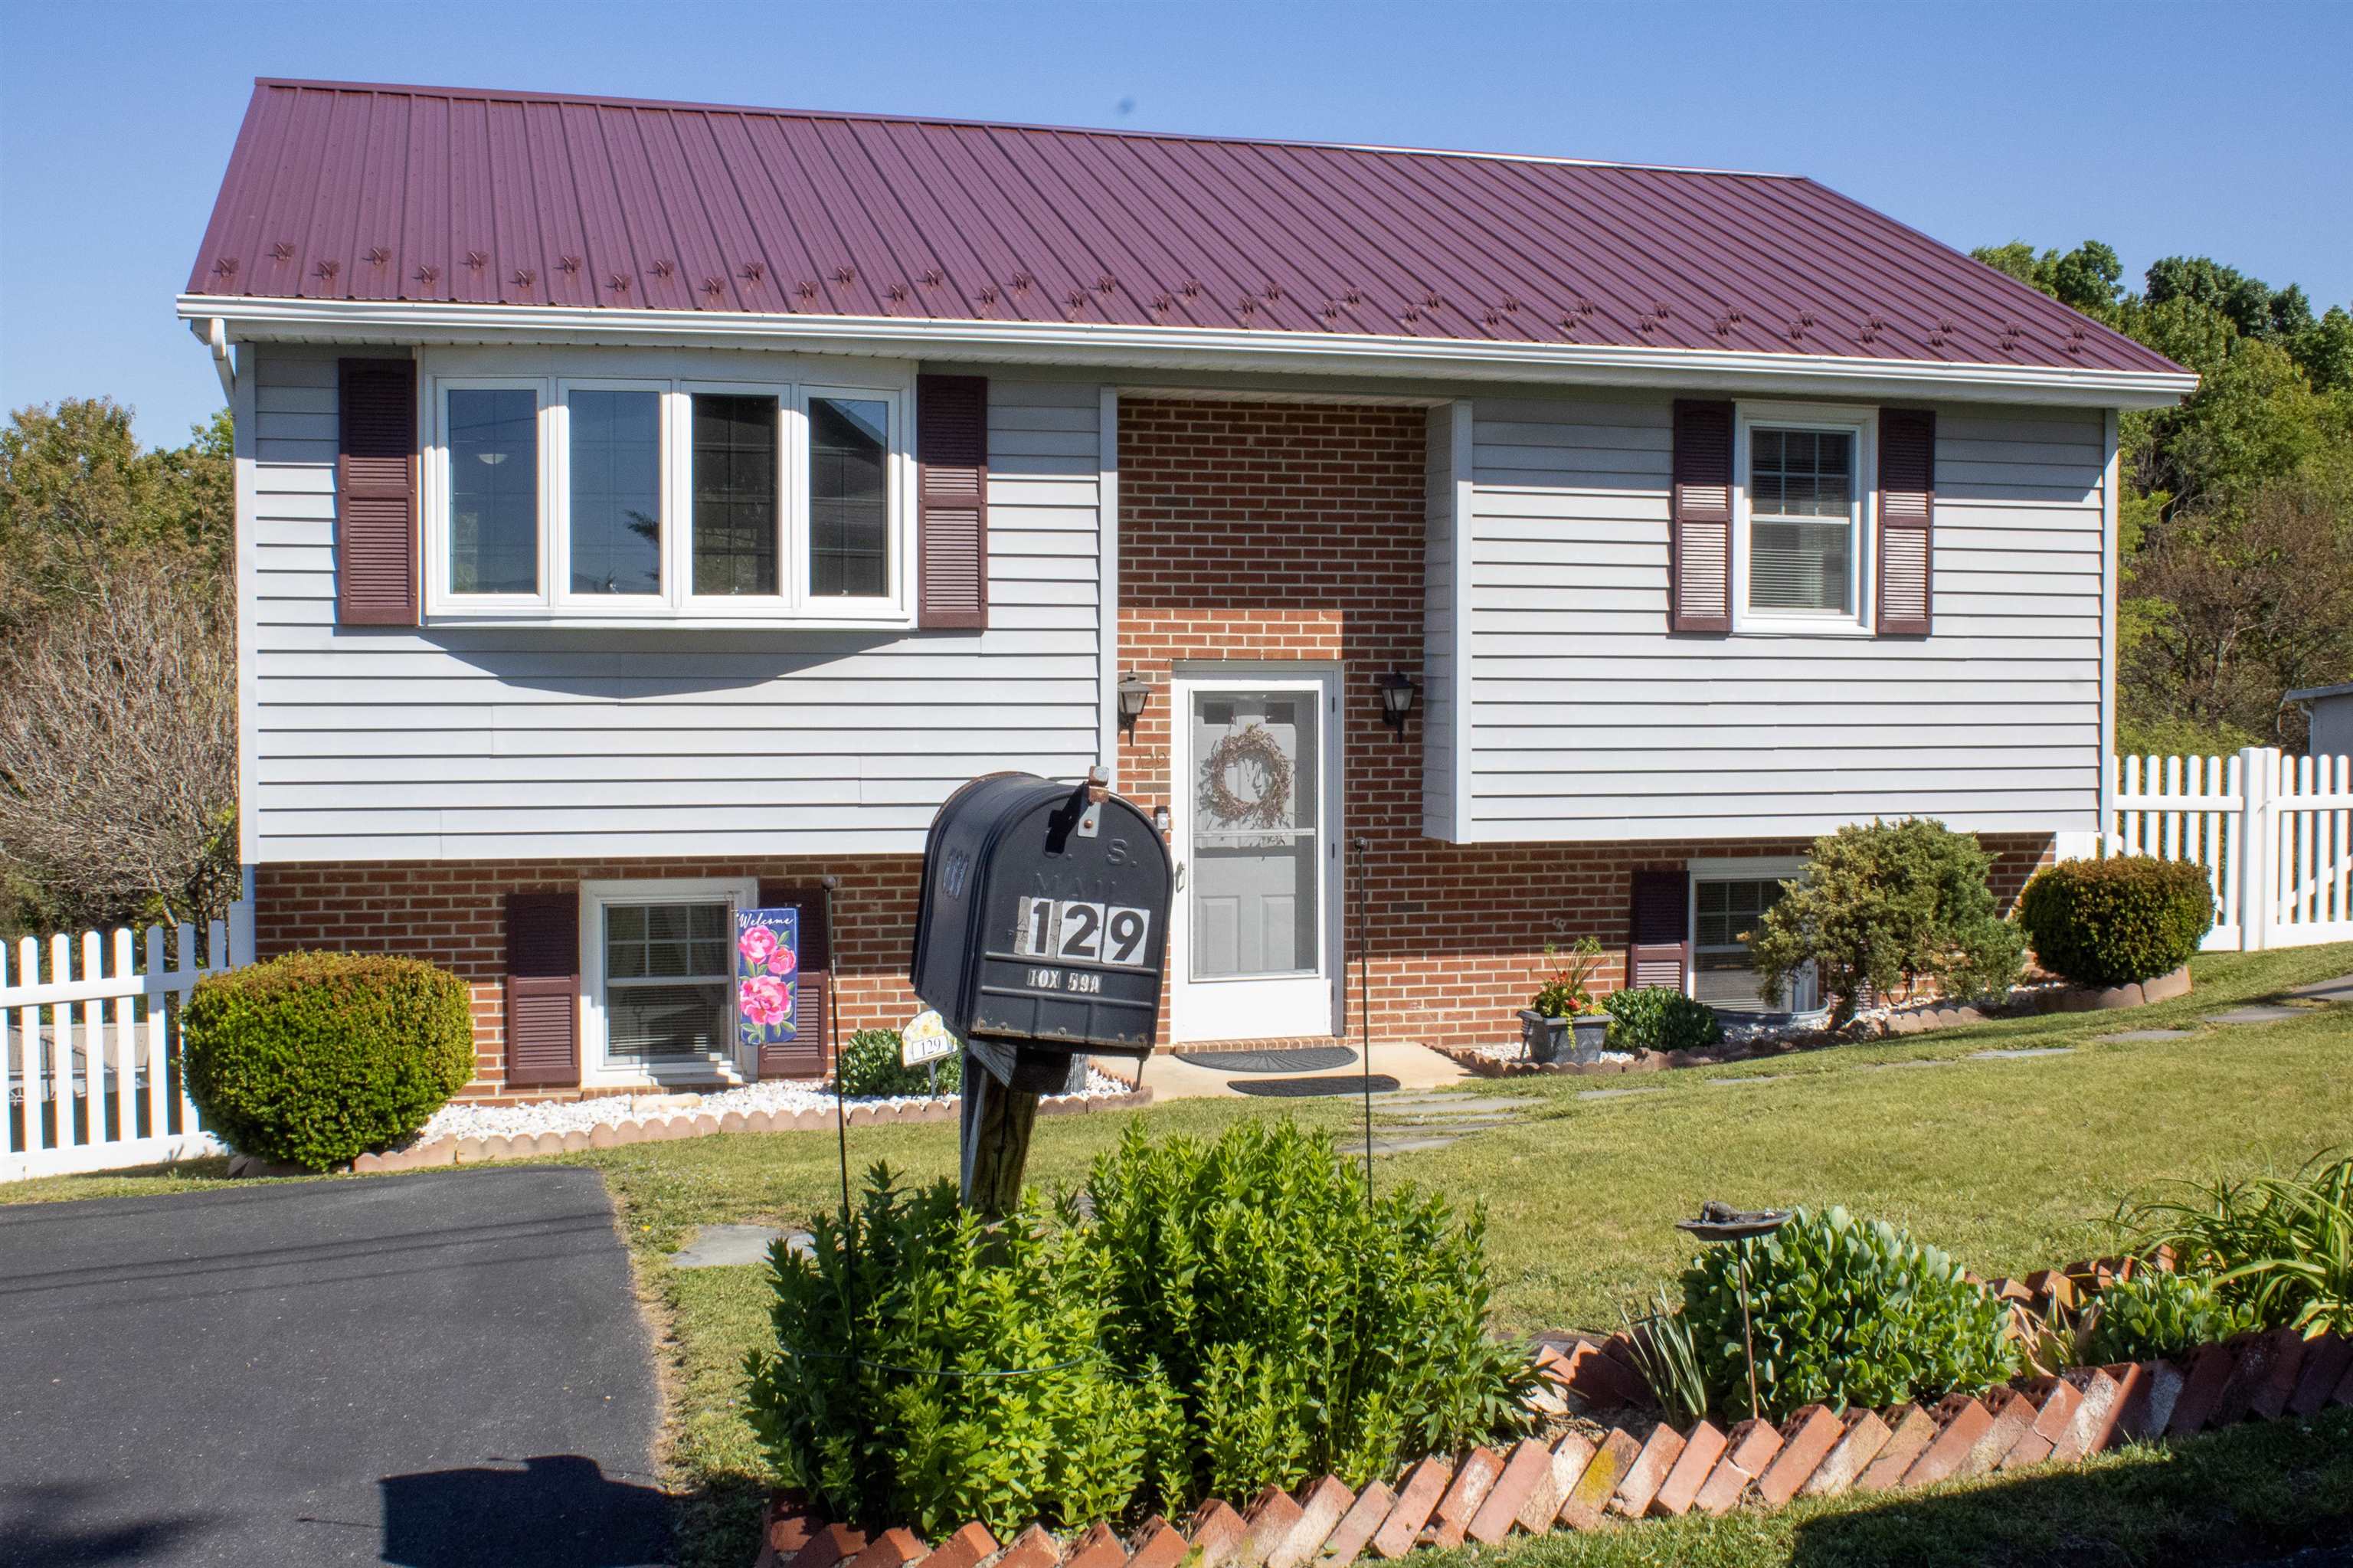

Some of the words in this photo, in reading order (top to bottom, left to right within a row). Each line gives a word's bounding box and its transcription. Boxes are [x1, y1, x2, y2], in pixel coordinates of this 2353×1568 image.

[736, 912, 794, 929] Welcome
[1033, 901, 1145, 962] 129
[921, 1038, 941, 1056] 129
